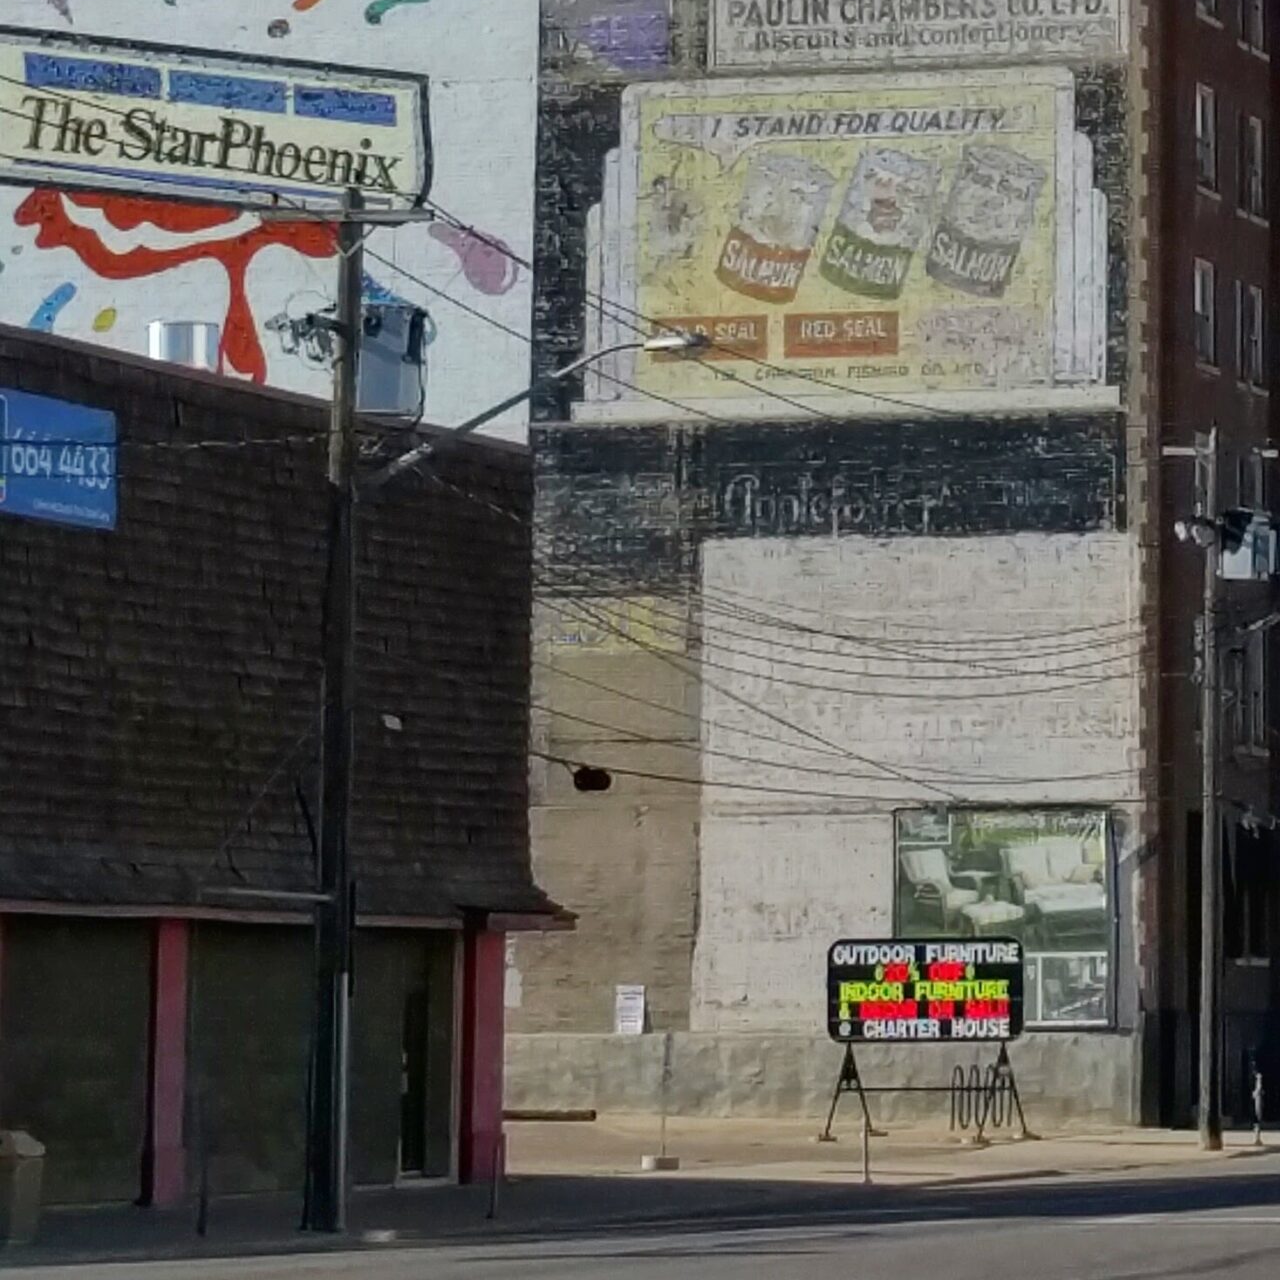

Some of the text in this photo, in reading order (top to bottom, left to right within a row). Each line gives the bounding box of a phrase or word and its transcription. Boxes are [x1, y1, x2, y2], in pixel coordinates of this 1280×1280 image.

[710, 108, 1006, 138] I STAND FOR QUALITY
[20, 95, 404, 191] The StarPhoenix
[722, 239, 803, 289] SALMON
[933, 232, 1011, 283] SALMON
[714, 321, 758, 341] SEAL
[799, 320, 887, 339] RED SEAL
[833, 942, 1019, 965] OUTDOOR FURNITURE
[839, 980, 1011, 1002] INDOOR FURNITURE
[862, 1019, 941, 1038] CHARTER
[950, 1018, 1011, 1038] HOUSE
